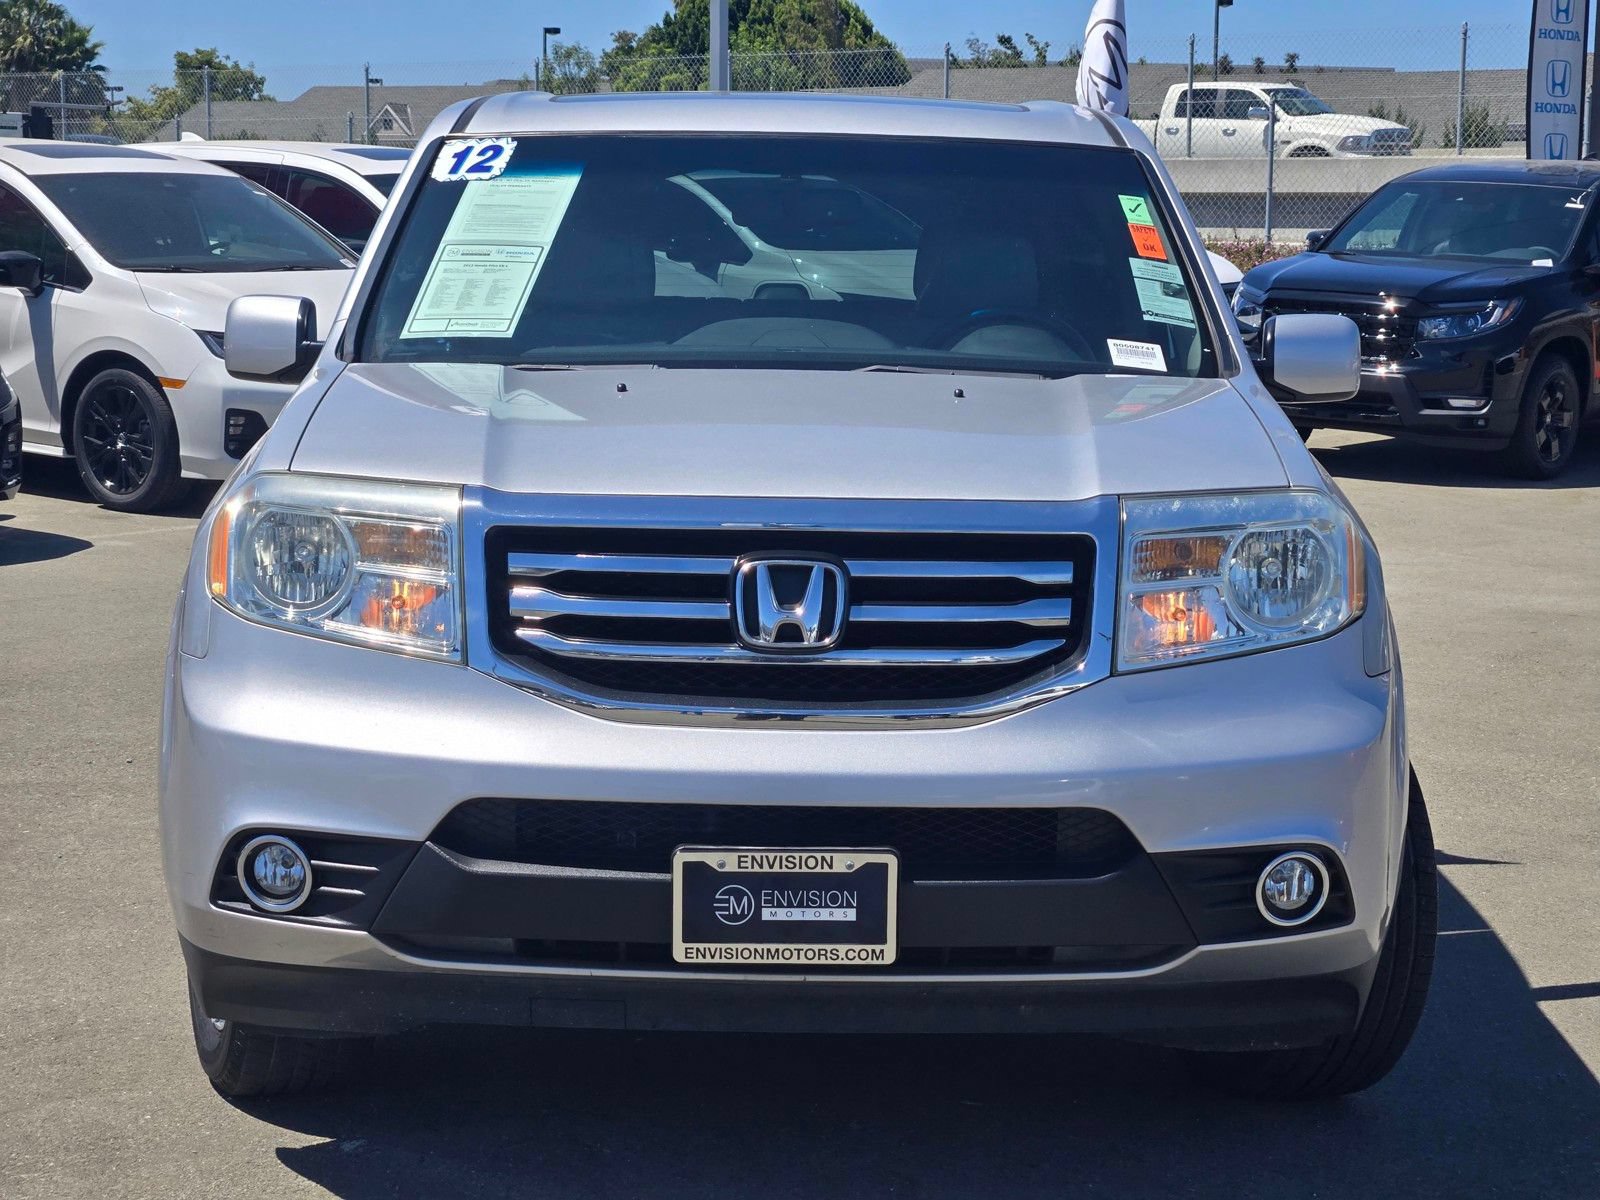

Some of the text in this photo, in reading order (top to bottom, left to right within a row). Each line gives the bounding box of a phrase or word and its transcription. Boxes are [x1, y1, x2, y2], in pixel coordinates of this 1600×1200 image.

[1538, 28, 1581, 42] HONDA
[1534, 102, 1578, 115] HONDA
[449, 144, 505, 174] 12
[1130, 224, 1156, 235] SAFETY
[1143, 243, 1157, 252] OK
[737, 854, 834, 871] ENVISION
[761, 890, 857, 907] ENVISION
[769, 910, 849, 919] MOTORS
[684, 946, 885, 962] ENVISIONMOTORS.COM
